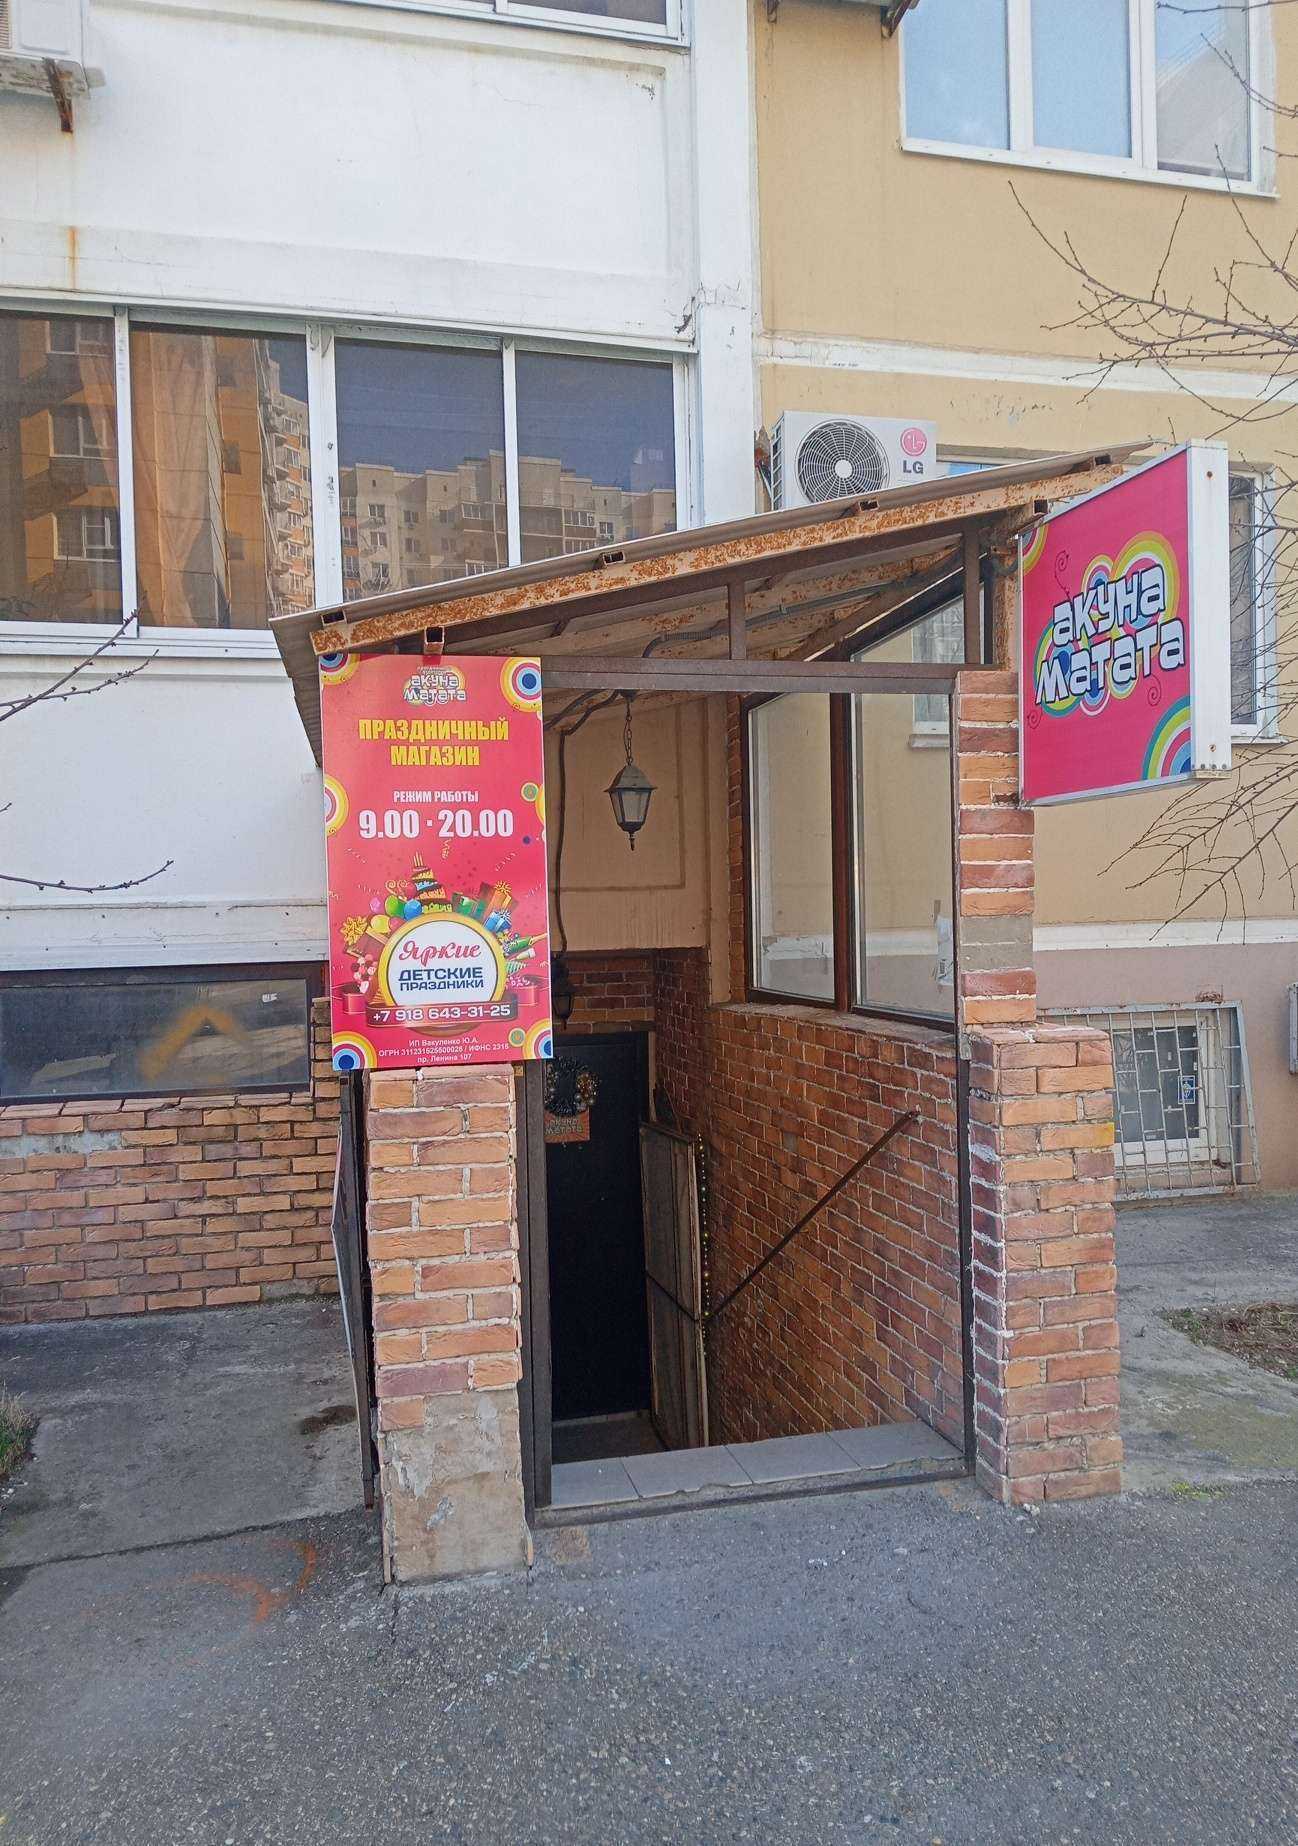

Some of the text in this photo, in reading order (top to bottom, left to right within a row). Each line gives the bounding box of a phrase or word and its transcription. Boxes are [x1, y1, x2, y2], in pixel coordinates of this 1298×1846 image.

[902, 460, 924, 475] LG
[358, 716, 510, 743] ПРАЗДНИЧНЫЙ
[390, 745, 481, 767] МАГАЗИН
[393, 790, 479, 804] РЕЖИМ РАБОТЫ
[359, 809, 420, 839] 9.00
[437, 808, 514, 838] 20.00
[398, 939, 482, 967] Яркие
[398, 966, 484, 982] ДЕТСКИЕ
[399, 979, 484, 992] ПРАЗДНИКИ
[372, 1004, 511, 1023] +7 918 643-31-25
[378, 1049, 400, 1057] ОГРН
[468, 1044, 491, 1052] ИФНС
[408, 1039, 421, 1048] ИП
